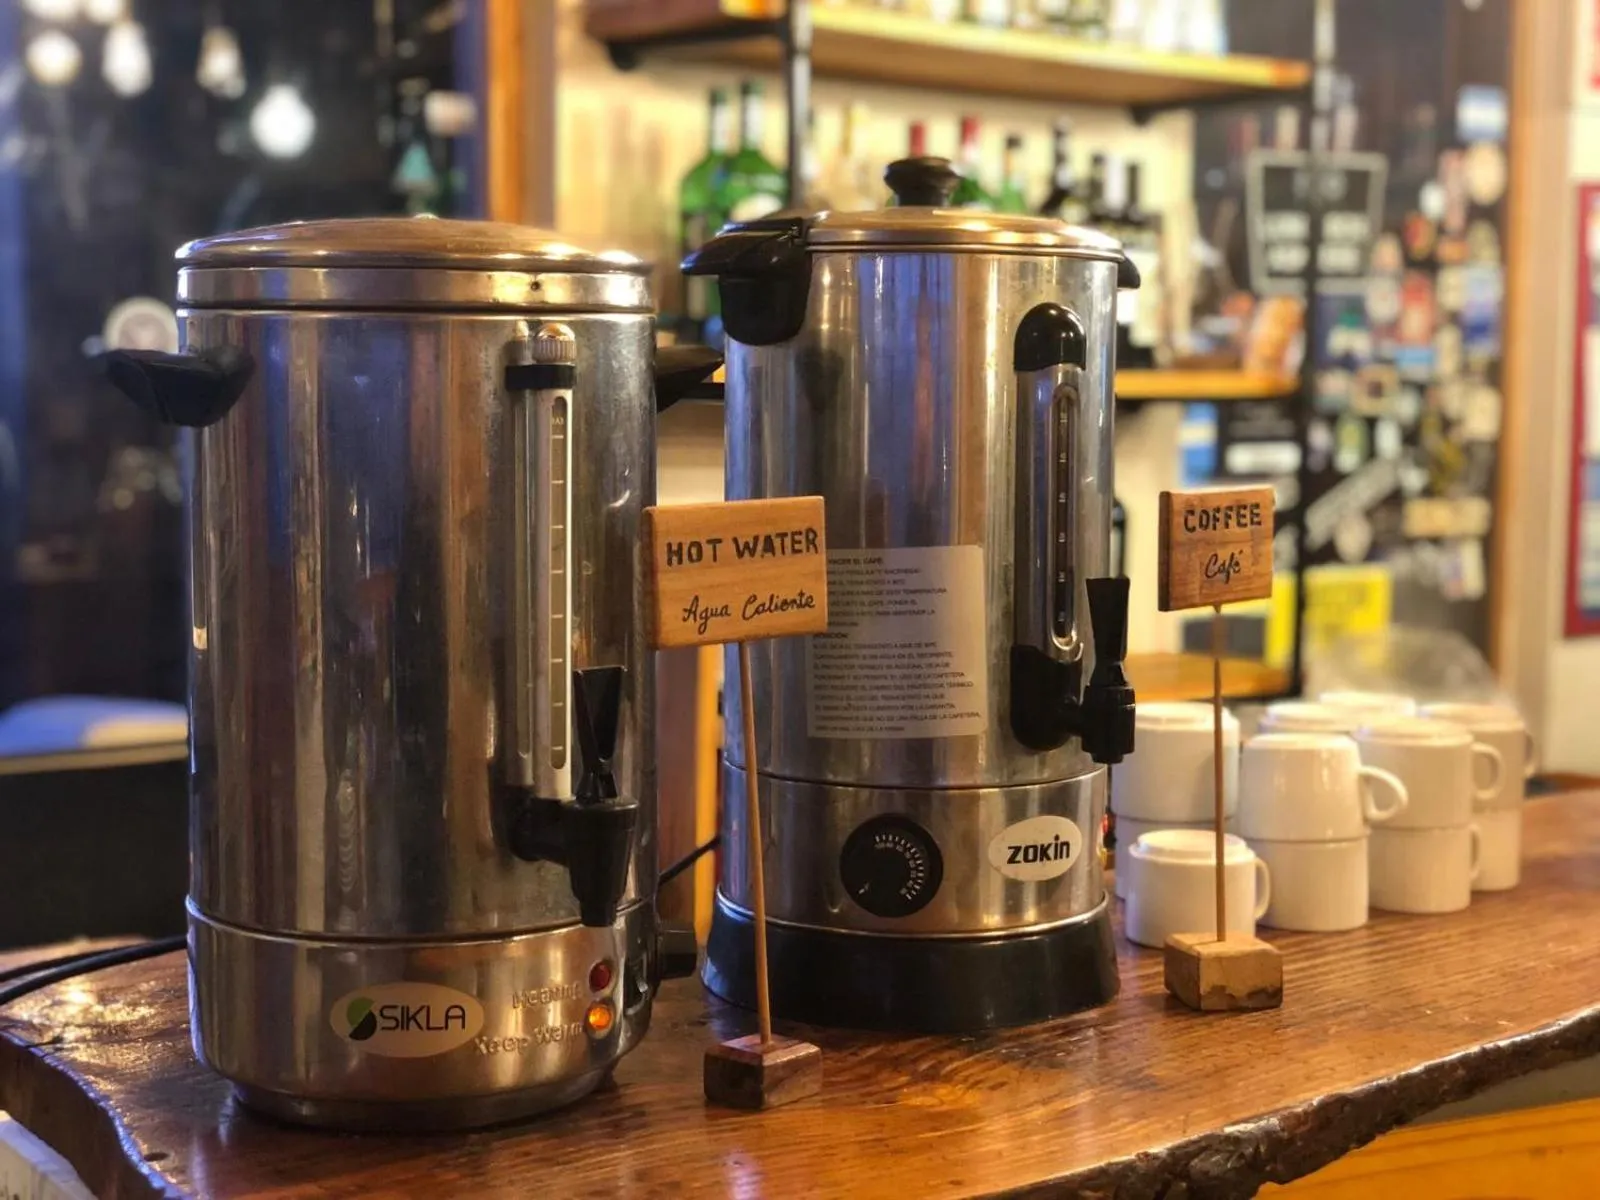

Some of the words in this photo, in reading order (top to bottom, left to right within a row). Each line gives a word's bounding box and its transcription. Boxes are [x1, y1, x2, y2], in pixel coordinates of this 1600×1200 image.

[1183, 503, 1262, 533] COFFEE
[666, 538, 723, 567] HOT
[732, 527, 819, 559] WATER
[1204, 550, 1243, 585] Café
[682, 595, 731, 635] Agua
[741, 589, 816, 621] Caliente
[379, 1004, 466, 1031] SIKLA
